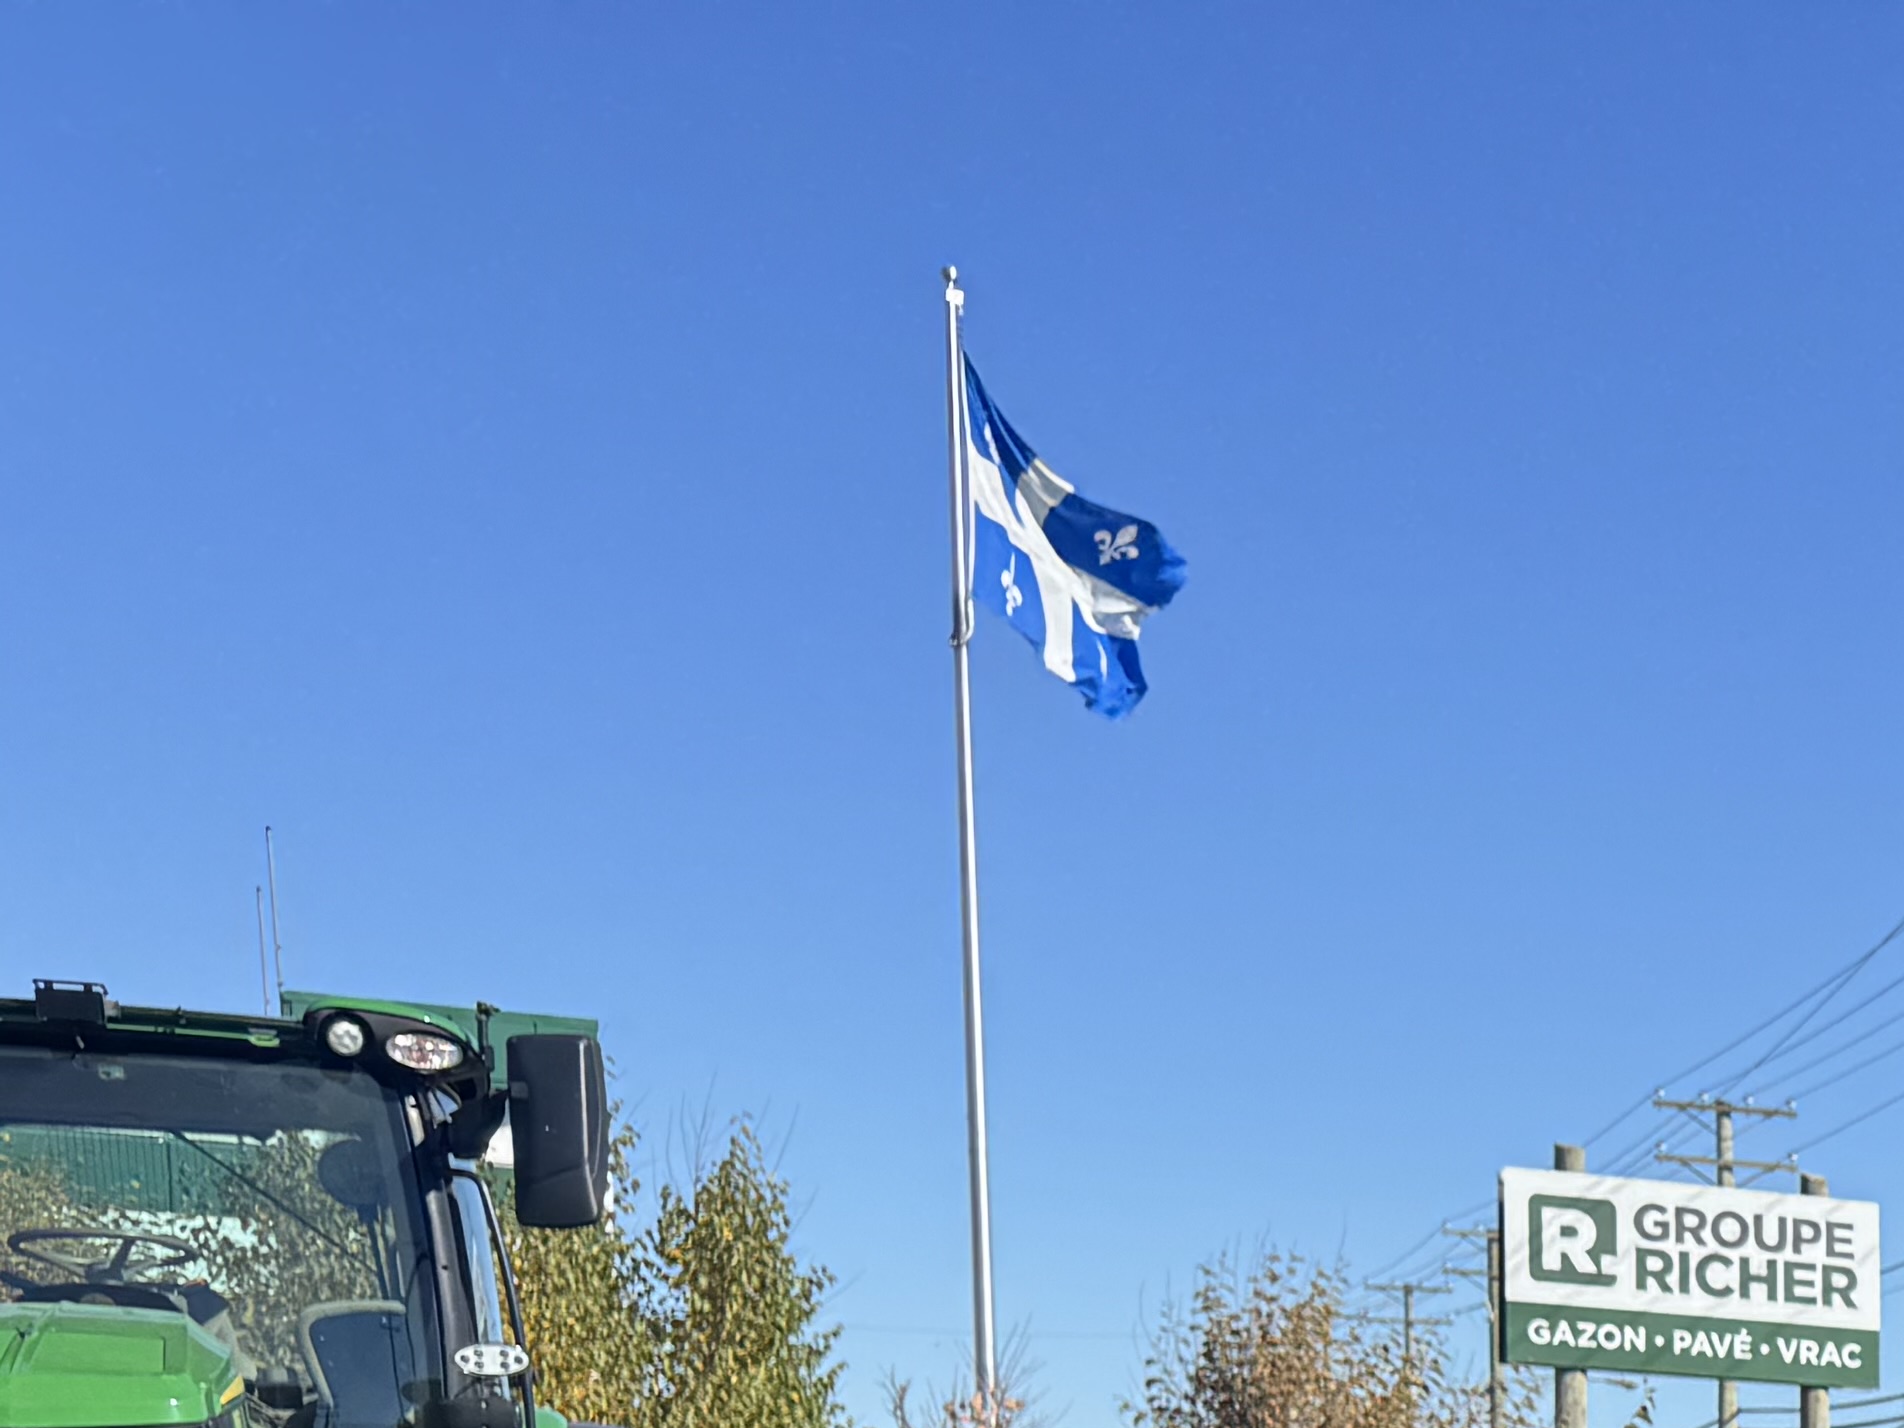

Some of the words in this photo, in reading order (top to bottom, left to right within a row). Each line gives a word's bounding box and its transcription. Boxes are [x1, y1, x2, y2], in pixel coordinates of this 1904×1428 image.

[1633, 1203, 1855, 1260] GROUPE
[1635, 1247, 1858, 1310] RICHER
[1527, 1317, 1646, 1353] GAZON
[1673, 1327, 1752, 1360] PAVÉ
[1776, 1338, 1862, 1369] VRAC
